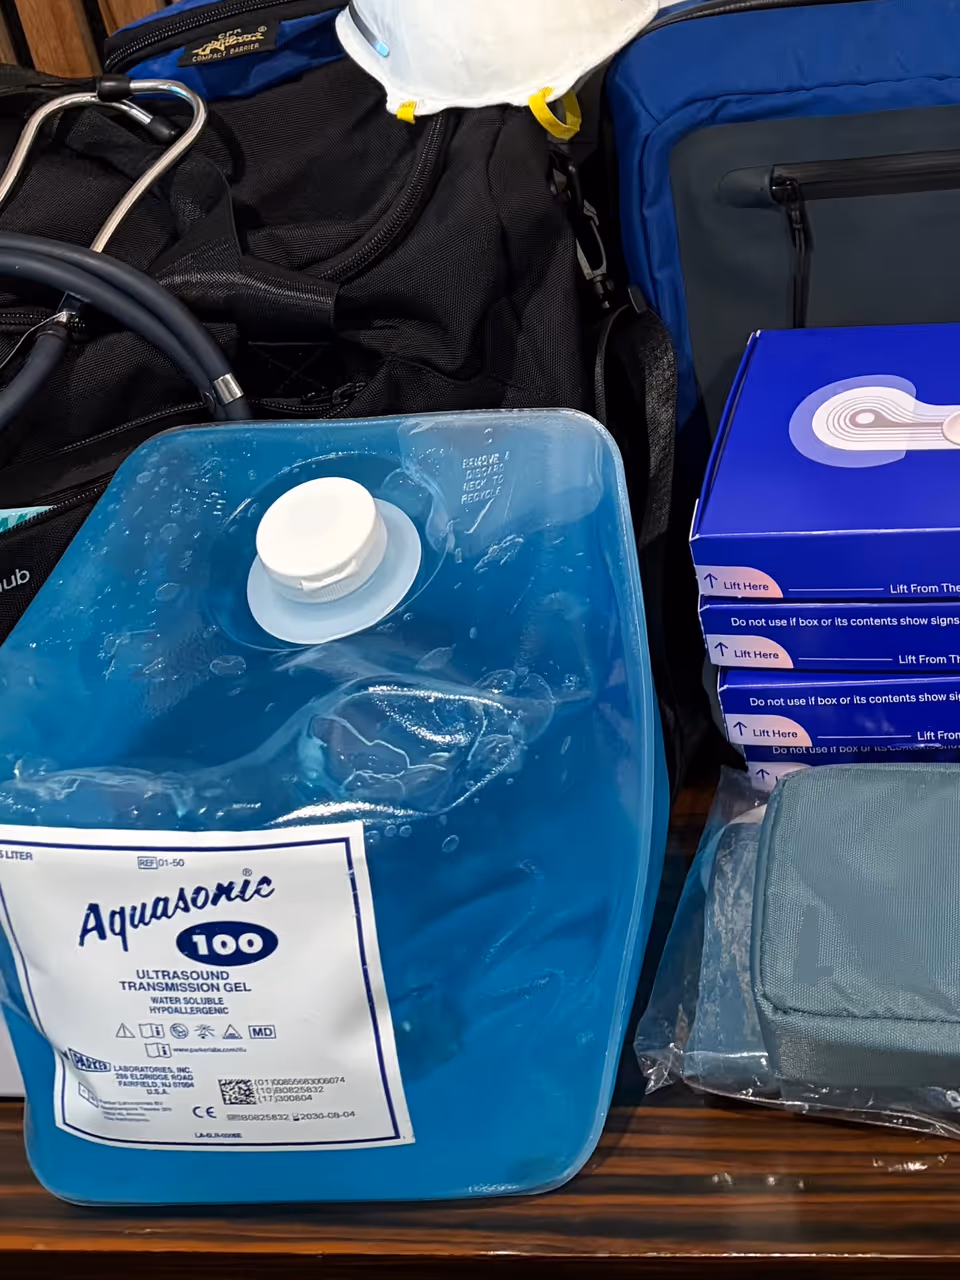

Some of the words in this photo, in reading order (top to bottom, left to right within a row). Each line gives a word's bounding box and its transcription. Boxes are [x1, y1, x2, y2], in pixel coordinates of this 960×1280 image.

[890, 584, 908, 594] Lift
[910, 584, 939, 593] From
[731, 617, 746, 626] Do
[749, 618, 766, 626] not
[790, 617, 796, 626] if
[799, 617, 819, 626] box
[835, 617, 848, 626] its
[850, 617, 898, 626] contents
[900, 616, 928, 625] show
[931, 616, 960, 627] signs
[79, 876, 275, 952] Aquasonic
[192, 933, 263, 955] 100
[136, 970, 229, 980] ULTRASOUND
[119, 981, 221, 992] TRANSMISSION
[223, 982, 252, 992] GEL
[151, 996, 182, 1005] WATER
[183, 997, 224, 1005] SOLUBLE
[149, 1006, 229, 1015] HYPOALLERGENIC
